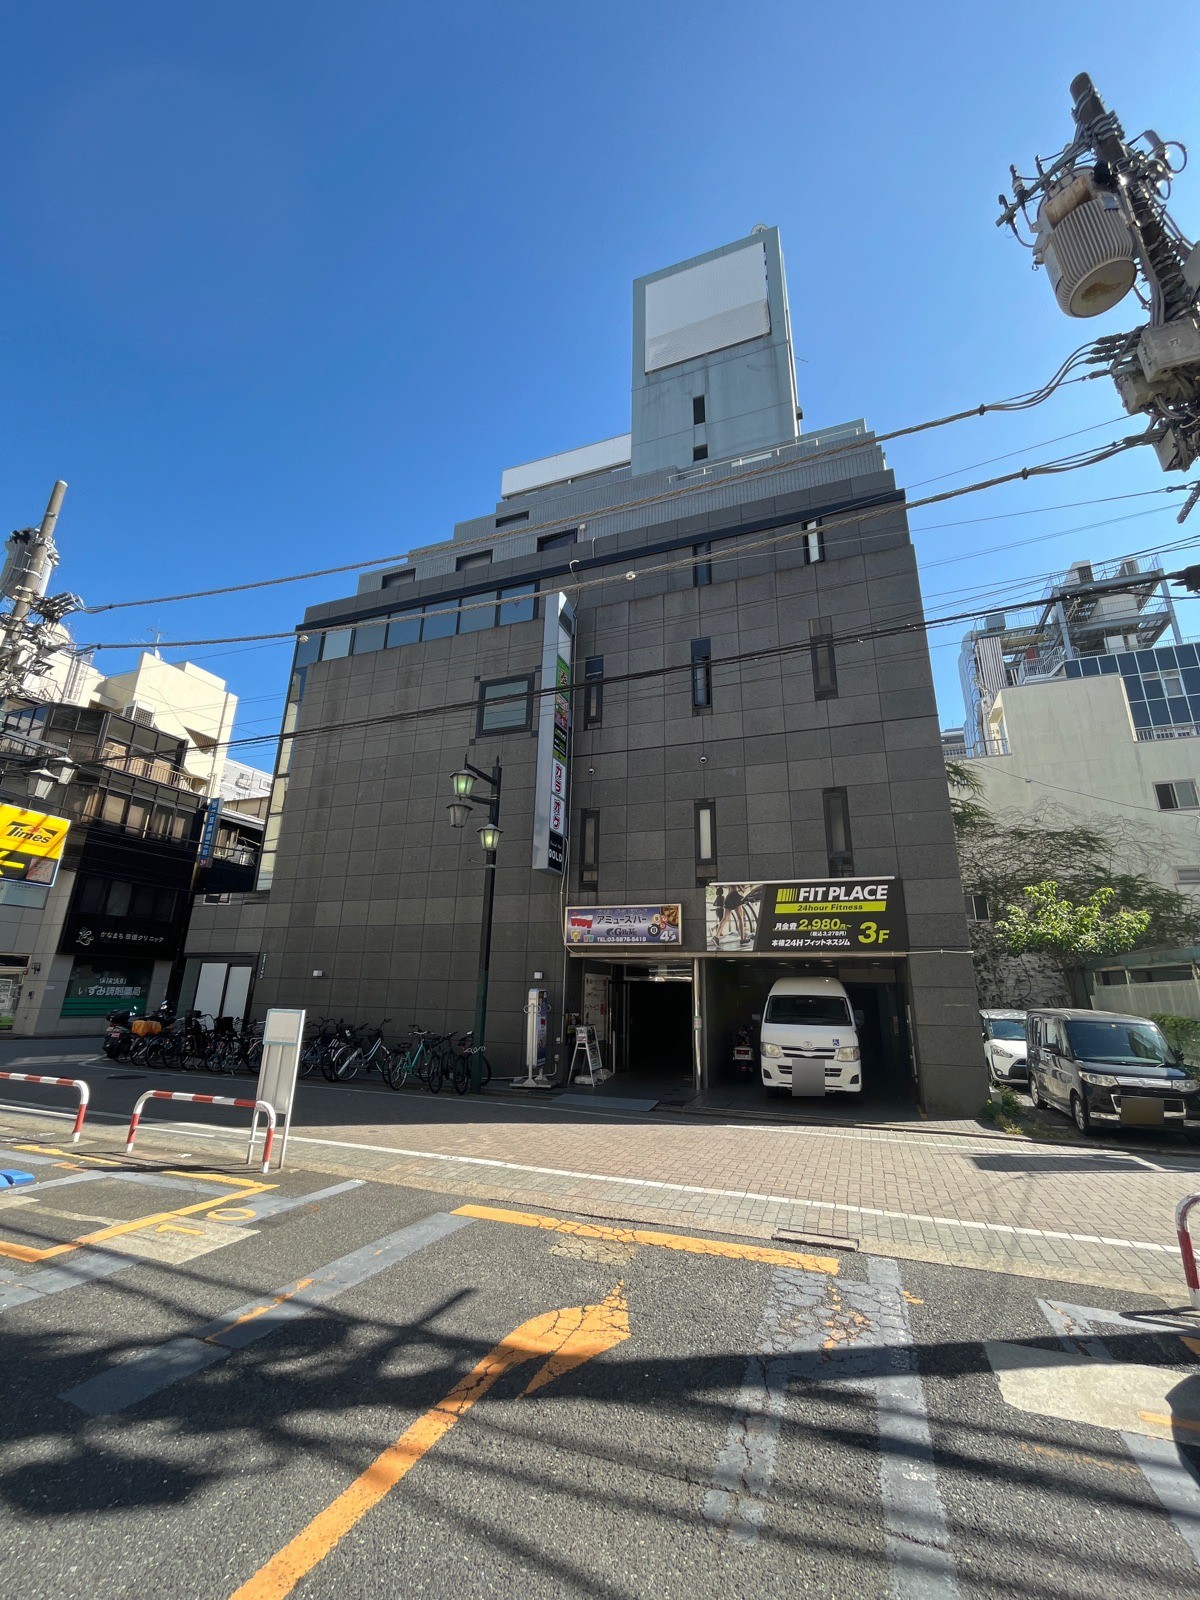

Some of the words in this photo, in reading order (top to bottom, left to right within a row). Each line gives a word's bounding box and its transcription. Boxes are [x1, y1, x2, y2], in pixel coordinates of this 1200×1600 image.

[6, 821, 52, 844] Times
[548, 849, 563, 863] GOLD
[798, 886, 827, 901] FIT
[828, 884, 889, 900] PLACE
[797, 904, 829, 912] 24hour
[830, 903, 863, 911] Fitness
[597, 915, 647, 924] アミュースバー
[858, 921, 890, 944] 3F
